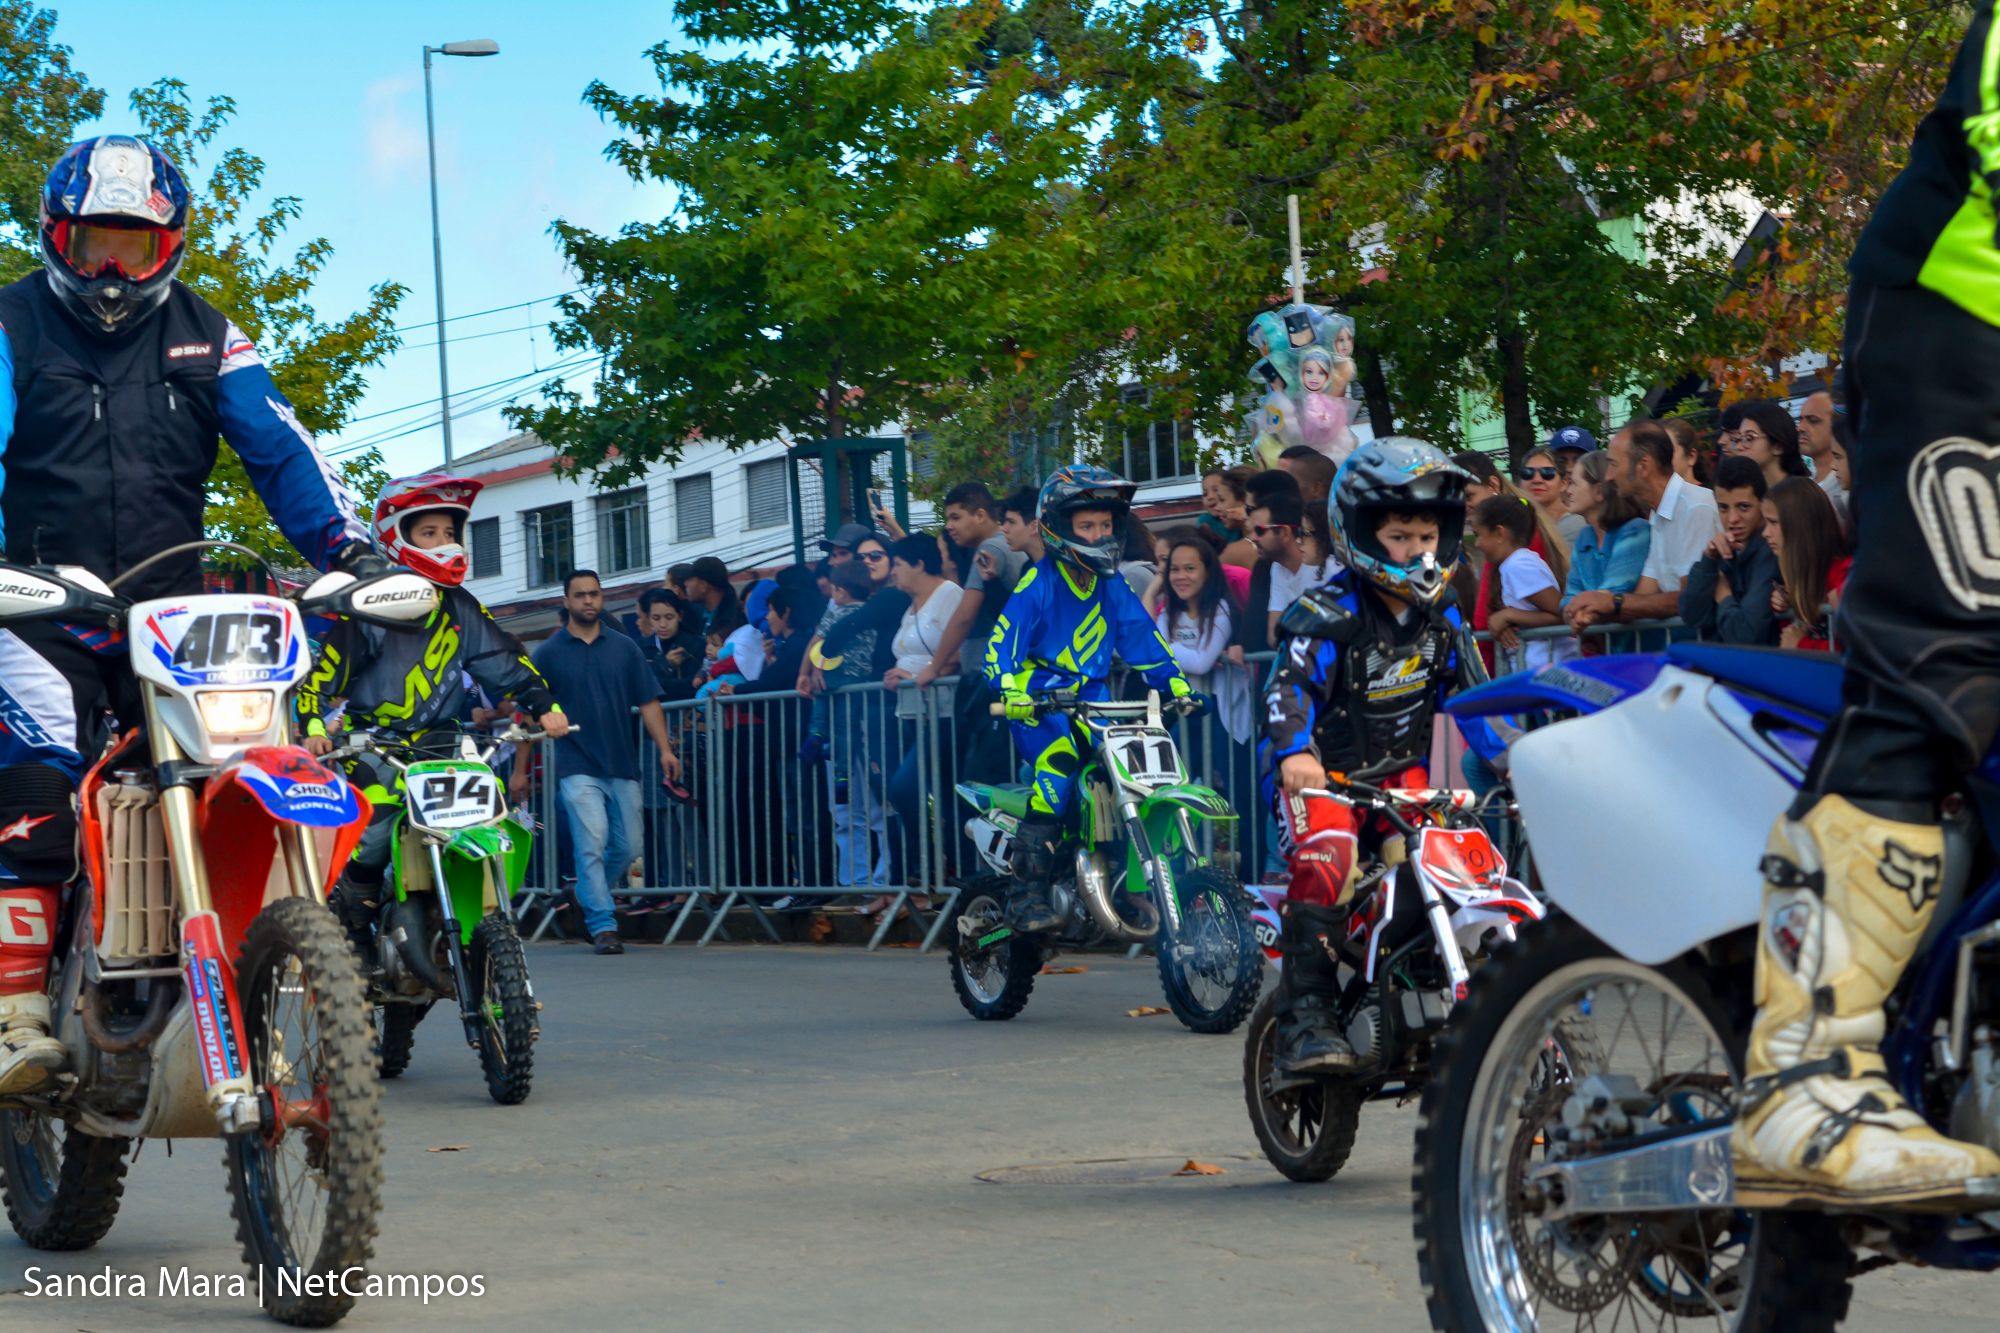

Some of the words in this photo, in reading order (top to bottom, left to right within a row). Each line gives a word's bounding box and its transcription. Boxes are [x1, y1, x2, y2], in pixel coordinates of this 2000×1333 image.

[172, 613, 282, 669] 403
[1117, 740, 1177, 775] 11
[288, 801, 345, 815] HONDA
[422, 776, 490, 812] 94
[1451, 848, 1484, 868] 50
[197, 1000, 226, 1082] DUNLOP
